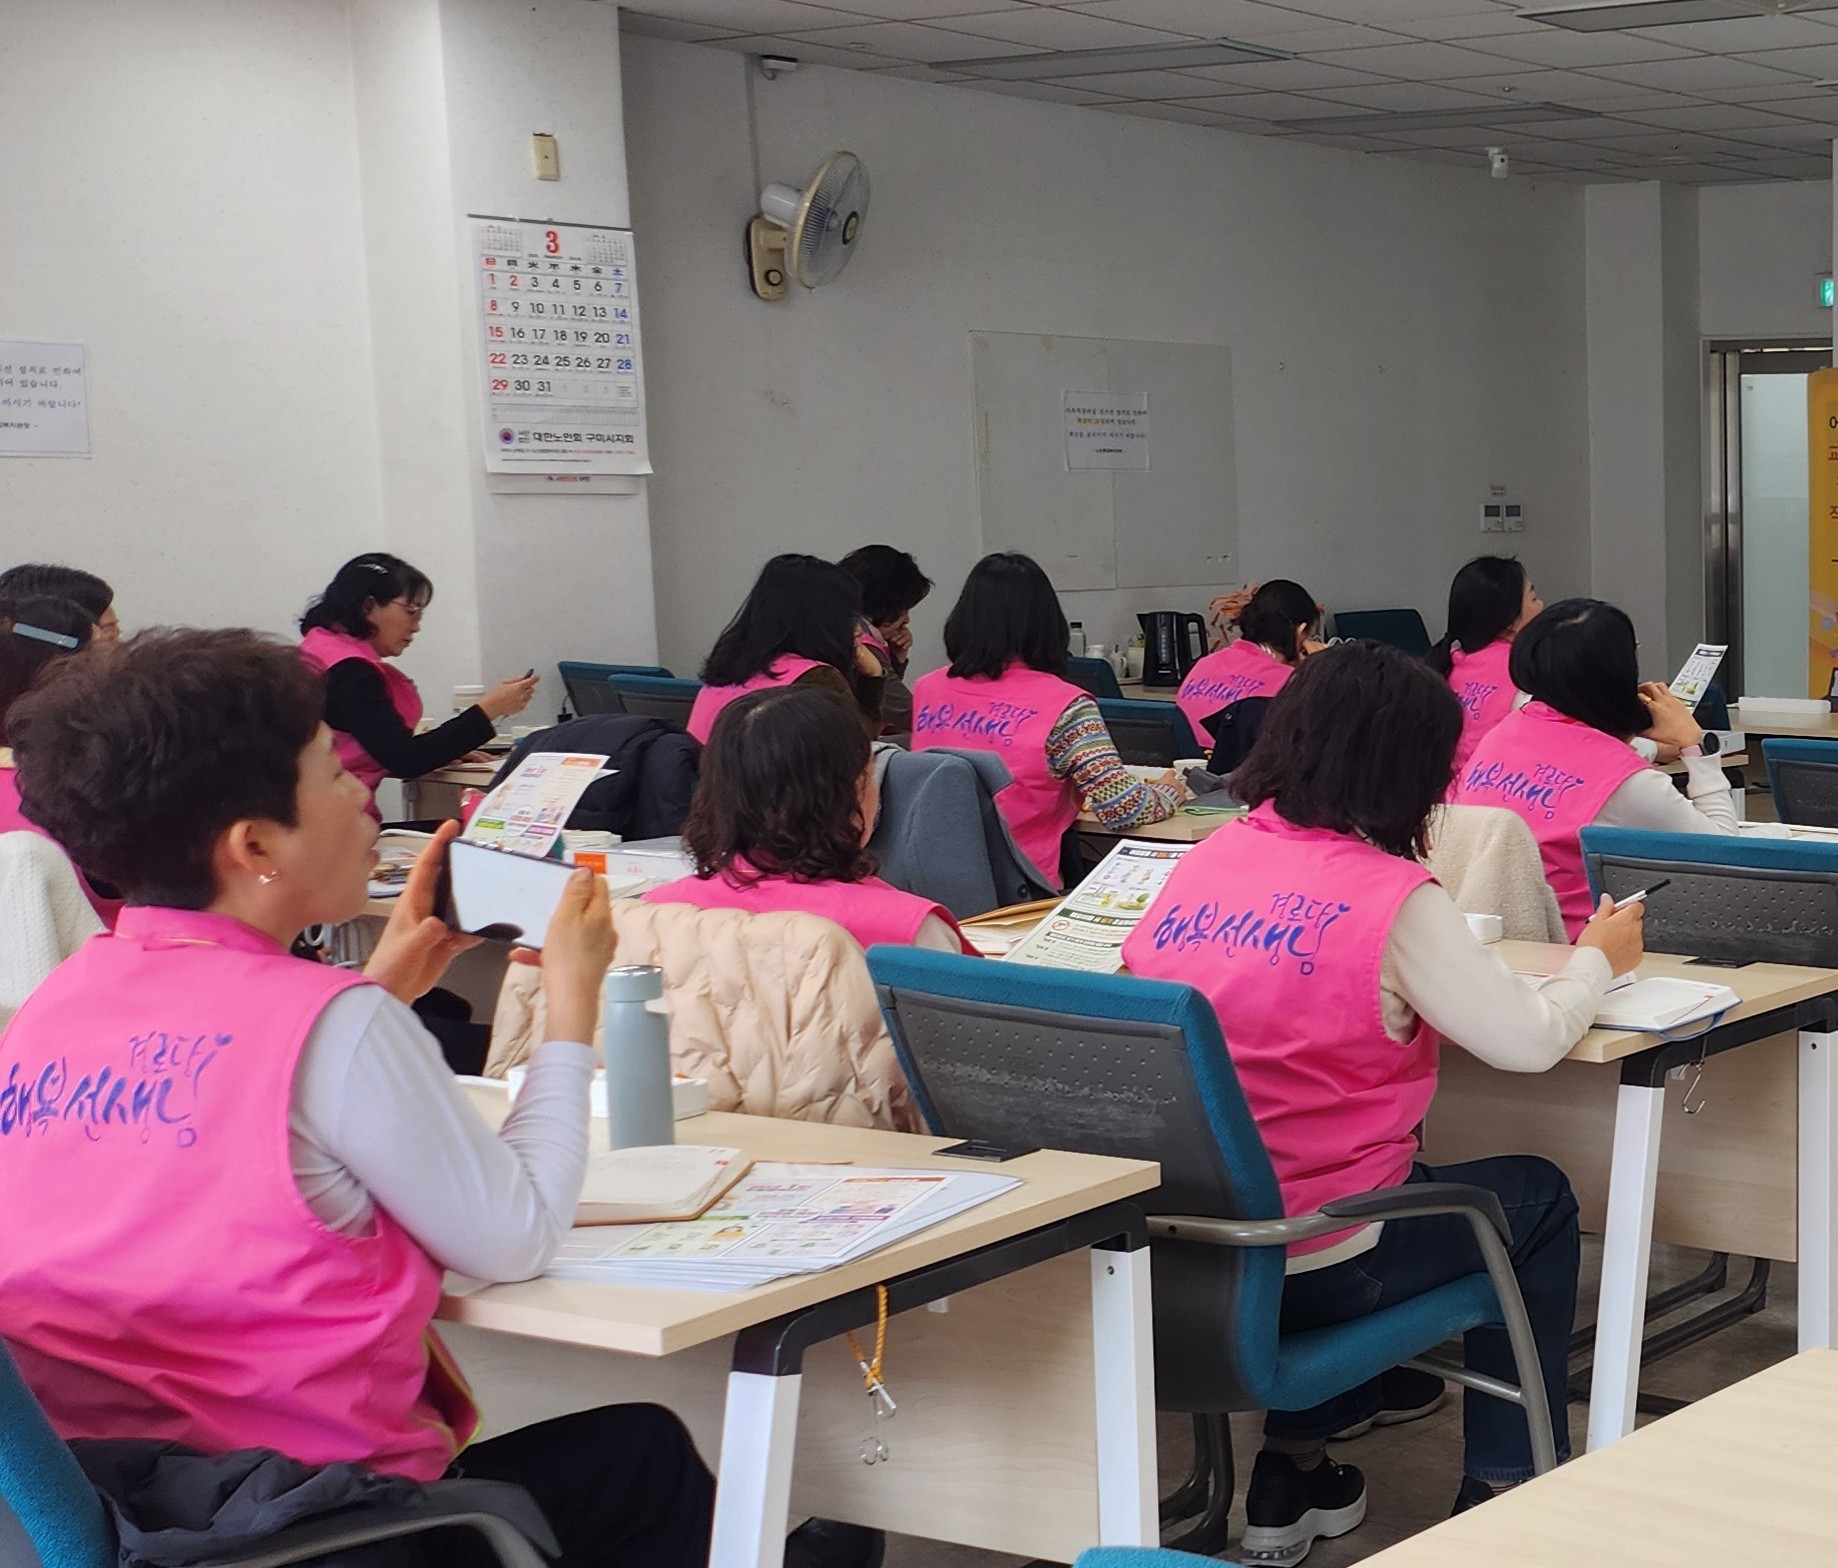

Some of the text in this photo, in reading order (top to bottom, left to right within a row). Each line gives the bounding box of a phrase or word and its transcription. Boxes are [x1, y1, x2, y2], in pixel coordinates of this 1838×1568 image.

[545, 230, 560, 254] 3
[489, 273, 622, 293] 1 2 3 4 5 6 7
[490, 300, 628, 319] 8 9 10 11 12 13 14
[489, 326, 630, 344] 15 16 17 18 19 20 21
[489, 353, 632, 370] 22 23 24 25 26 27 28
[492, 379, 508, 391] 29
[514, 380, 530, 391] 30
[537, 381, 551, 392] 31
[1271, 892, 1334, 928] 경로당
